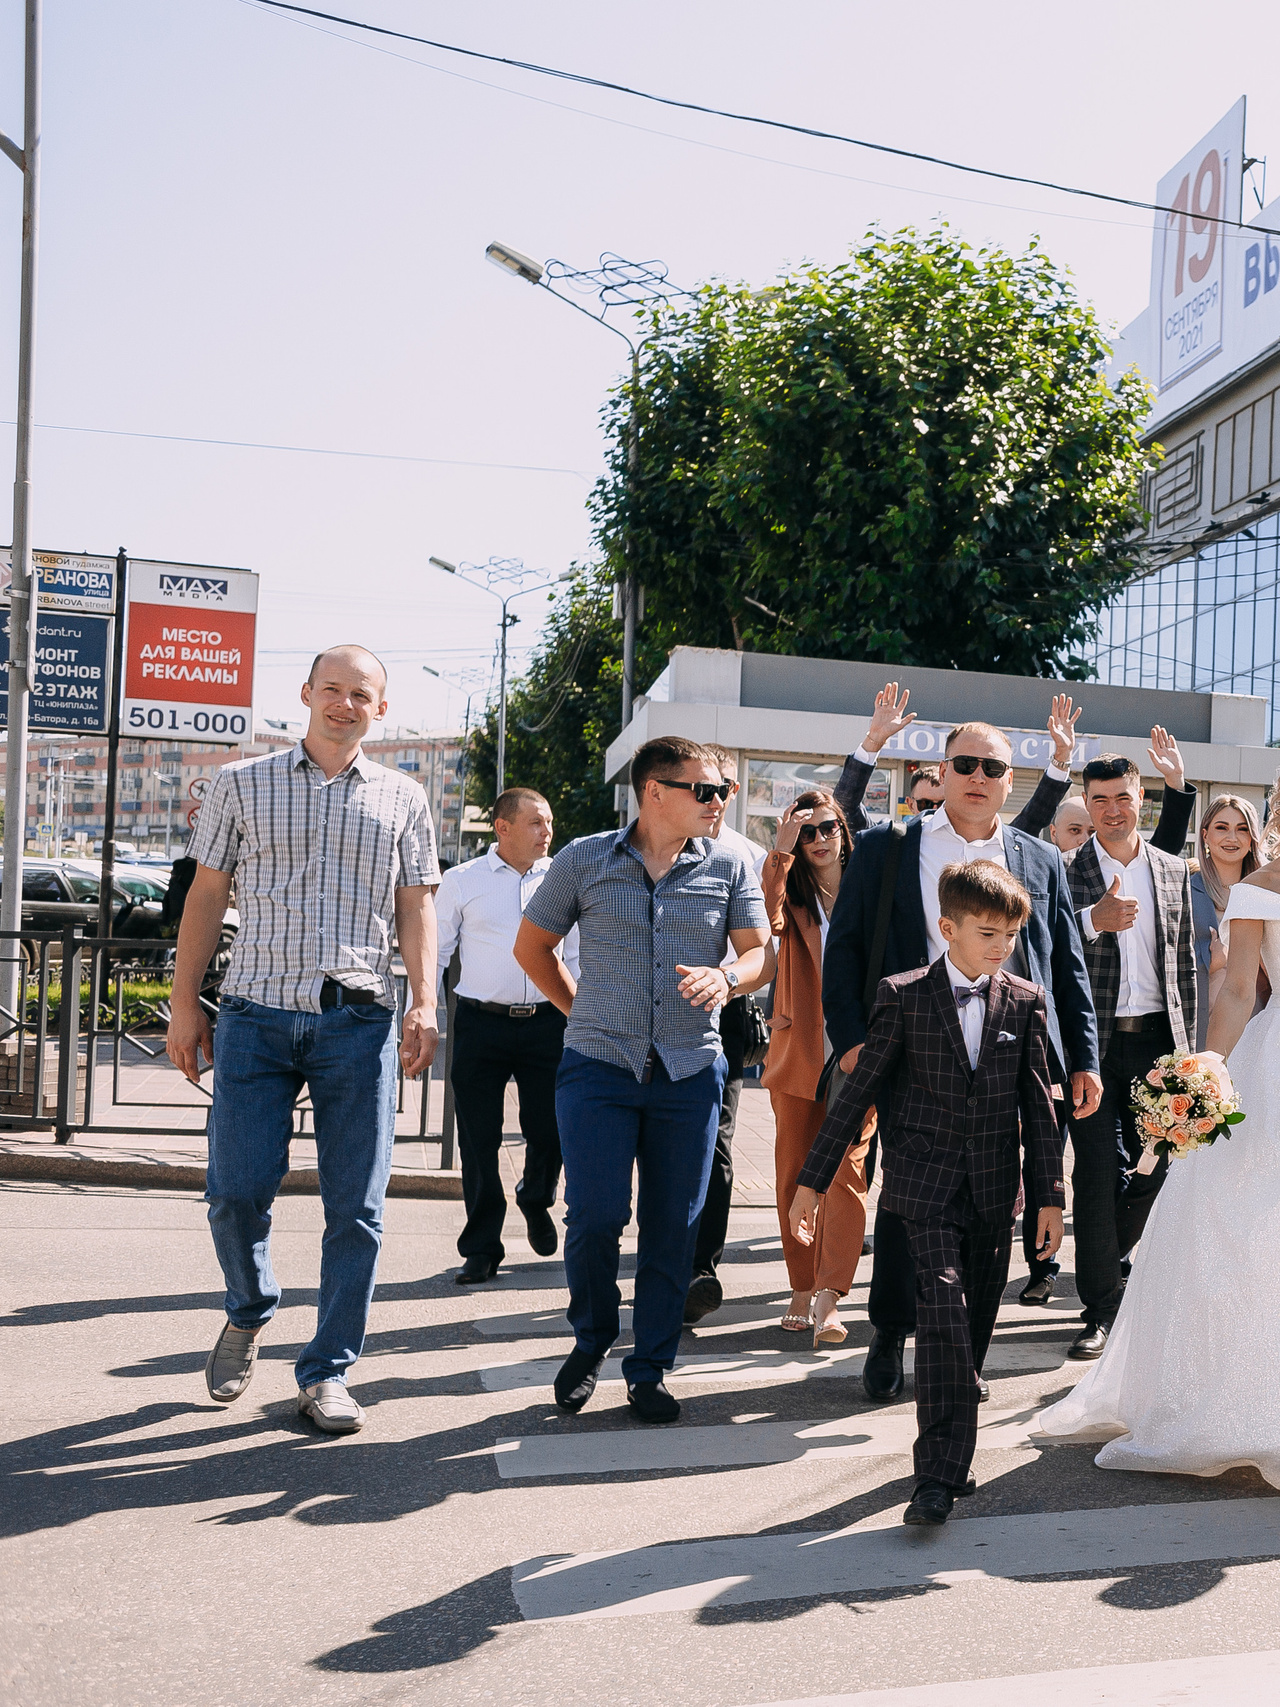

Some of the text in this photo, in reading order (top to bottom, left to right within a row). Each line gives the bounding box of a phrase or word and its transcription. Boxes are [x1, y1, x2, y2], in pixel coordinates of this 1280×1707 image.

[1169, 148, 1221, 298] 19
[1164, 280, 1219, 341] СЕНТЯБРЯ
[1178, 321, 1203, 359] 2021
[36, 567, 110, 590] РБАНОВА
[161, 576, 226, 597] MAX
[37, 595, 110, 610] RBANOVA street
[83, 588, 110, 597] улица
[162, 590, 224, 602] MEDIA
[161, 627, 223, 646] МЕСТО
[139, 643, 242, 666] ДЛЯ ВАШЕЙ
[141, 662, 239, 686] РЕКЛАМЫ
[33, 682, 98, 700] 2 ЭТАЖ
[33, 700, 45, 708] ТЦ
[82, 716, 99, 726] 16а
[128, 706, 247, 735] 501-000
